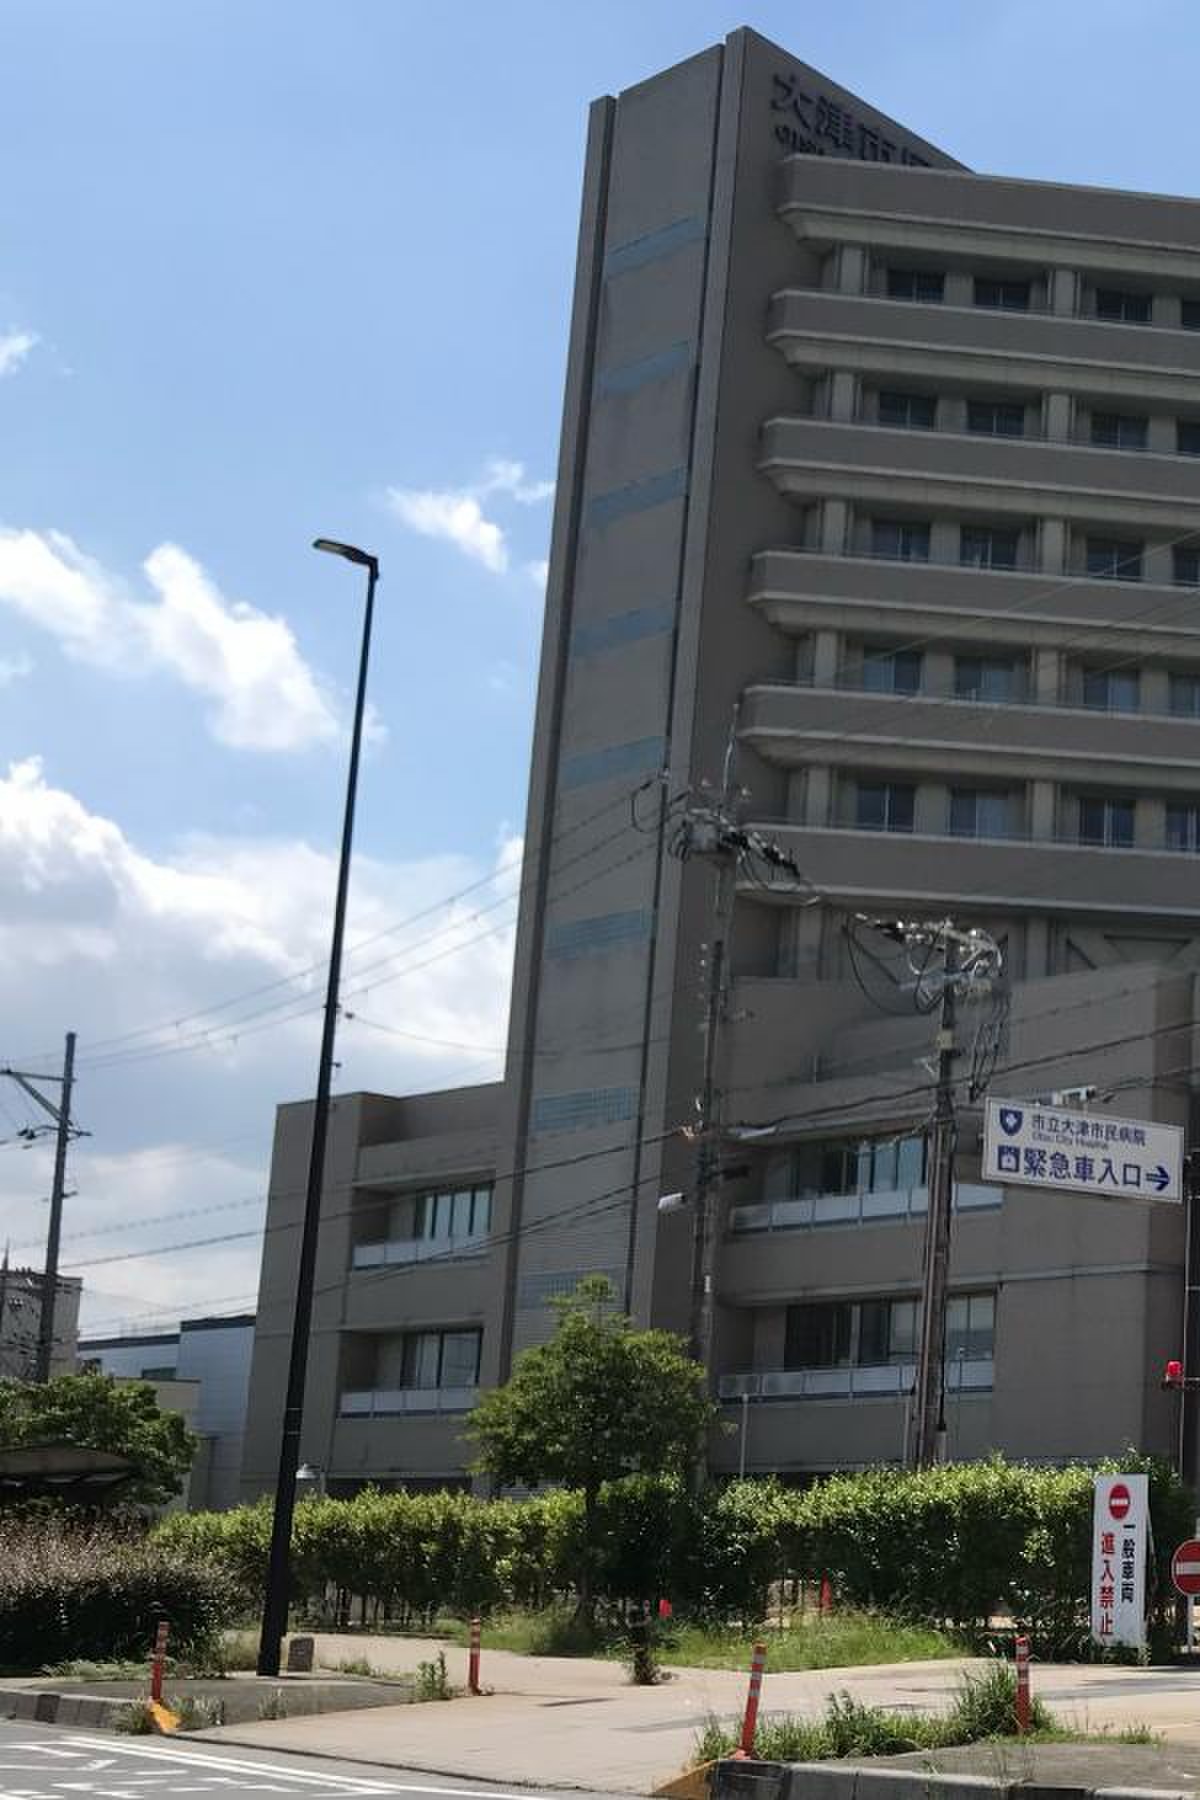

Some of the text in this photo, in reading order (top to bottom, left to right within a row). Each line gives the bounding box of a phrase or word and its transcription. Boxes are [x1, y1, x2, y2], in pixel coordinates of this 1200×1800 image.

[1032, 1115, 1146, 1146] 市立大津市民病院
[1023, 1148, 1141, 1187] 緊急車入口
[1099, 1532, 1115, 1635] 進入禁止
